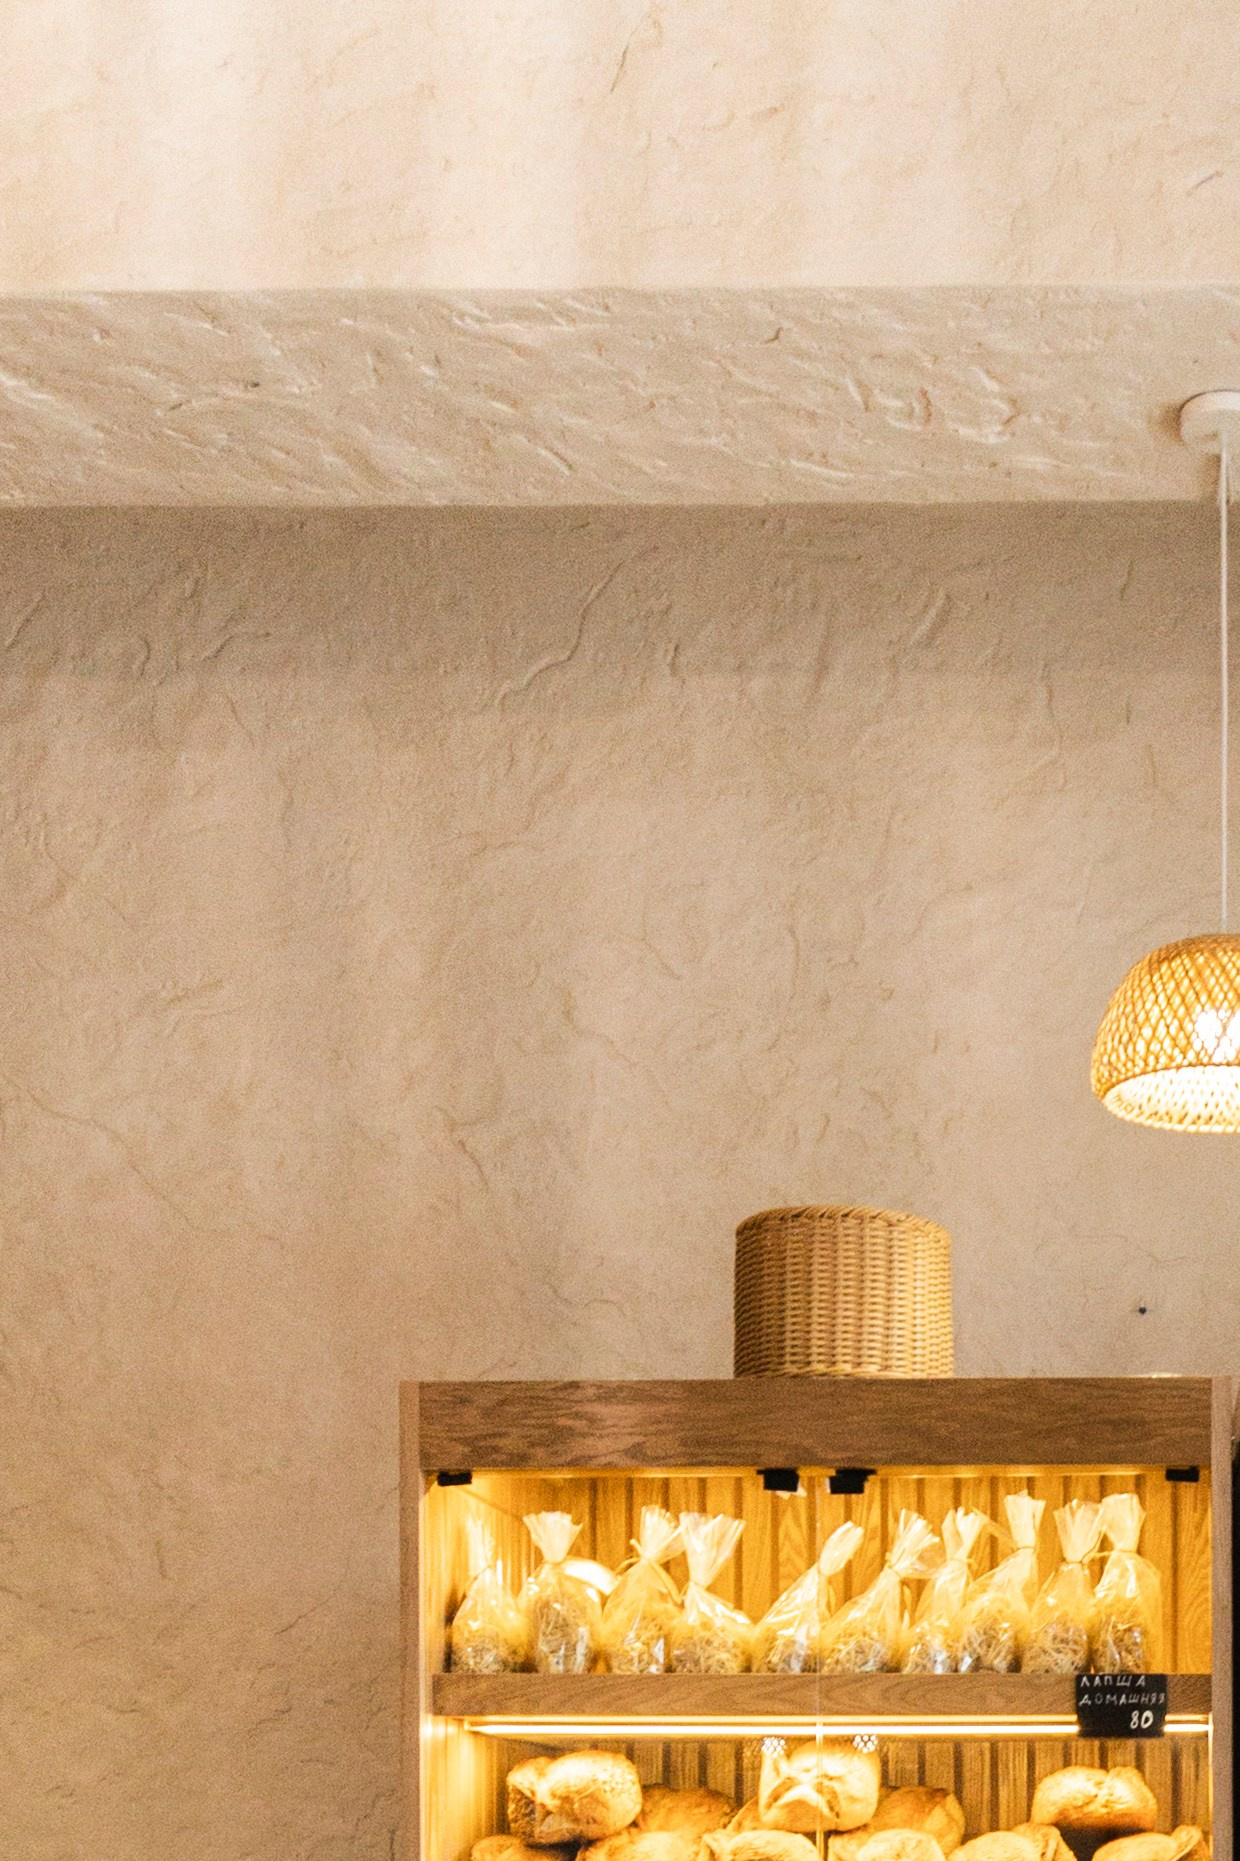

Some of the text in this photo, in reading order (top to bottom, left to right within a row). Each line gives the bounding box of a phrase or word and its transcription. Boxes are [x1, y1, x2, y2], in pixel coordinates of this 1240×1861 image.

[1080, 1675, 1146, 1687] ЛАПША
[1078, 1692, 1165, 1707] ДОМАШНЯЯ
[1130, 1709, 1154, 1730] 80
